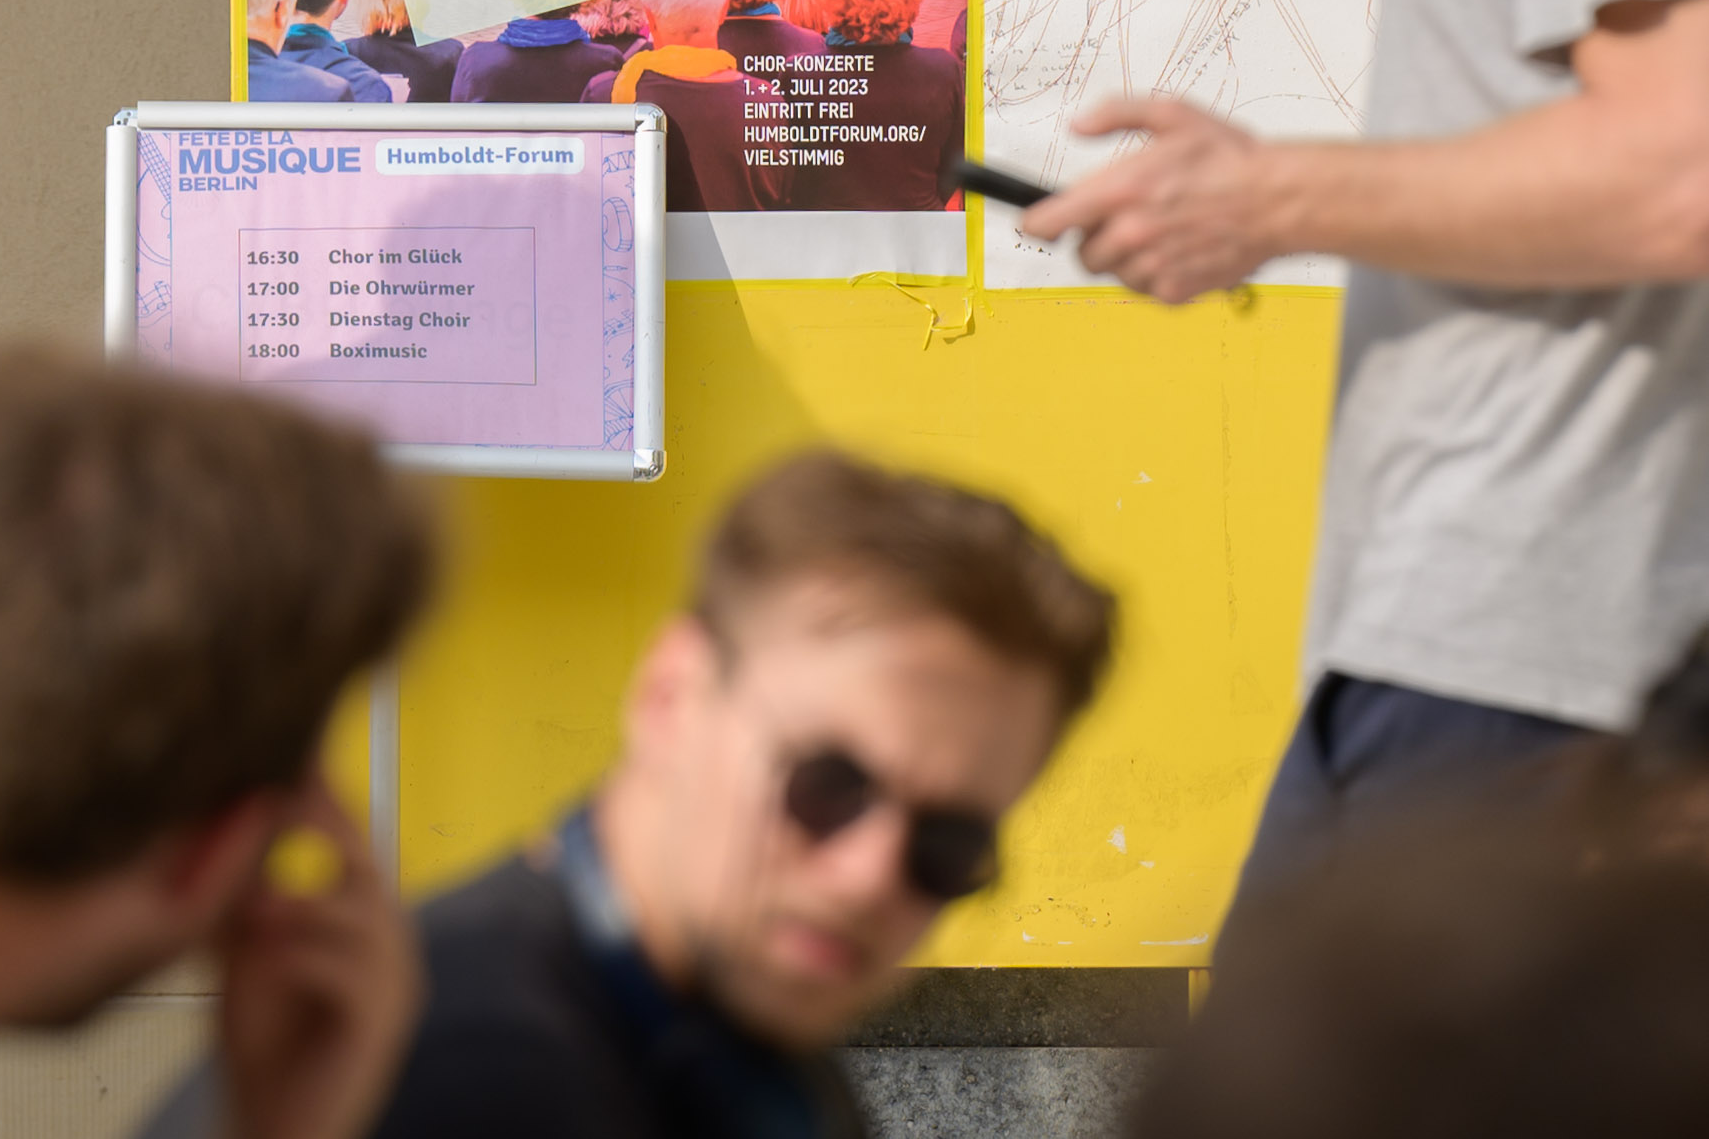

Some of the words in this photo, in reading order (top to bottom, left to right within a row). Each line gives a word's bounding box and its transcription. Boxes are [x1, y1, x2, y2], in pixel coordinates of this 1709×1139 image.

[743, 54, 875, 72] CHOR-KONZERTE
[743, 78, 755, 96] 1.
[758, 83, 768, 94] +
[770, 78, 785, 96] 2.
[789, 78, 824, 96] JULI
[828, 78, 869, 96] 2023
[744, 102, 815, 119] EINTRITT
[818, 102, 854, 119] FREI
[234, 130, 263, 146] DE
[267, 130, 294, 146] LA
[744, 125, 927, 143] HUMBOLDTFORUM.ORG/
[178, 146, 362, 175] MUSIQUE
[386, 146, 575, 165] Humboldt-Forum
[744, 149, 846, 166] VIELSTIMMIG
[178, 176, 258, 192] BERLIN
[246, 249, 301, 266] 16:30
[328, 249, 374, 265] Chor
[378, 249, 403, 265] im
[407, 248, 463, 265] Glück
[246, 280, 301, 297] 17:00
[328, 280, 361, 297] Die
[365, 279, 476, 297] Ohrwürmer
[246, 312, 301, 328] 17:30
[329, 311, 414, 331] Dienstag
[418, 311, 471, 329] Choir
[246, 343, 301, 359] 18:00
[329, 343, 428, 359] Boximusic
